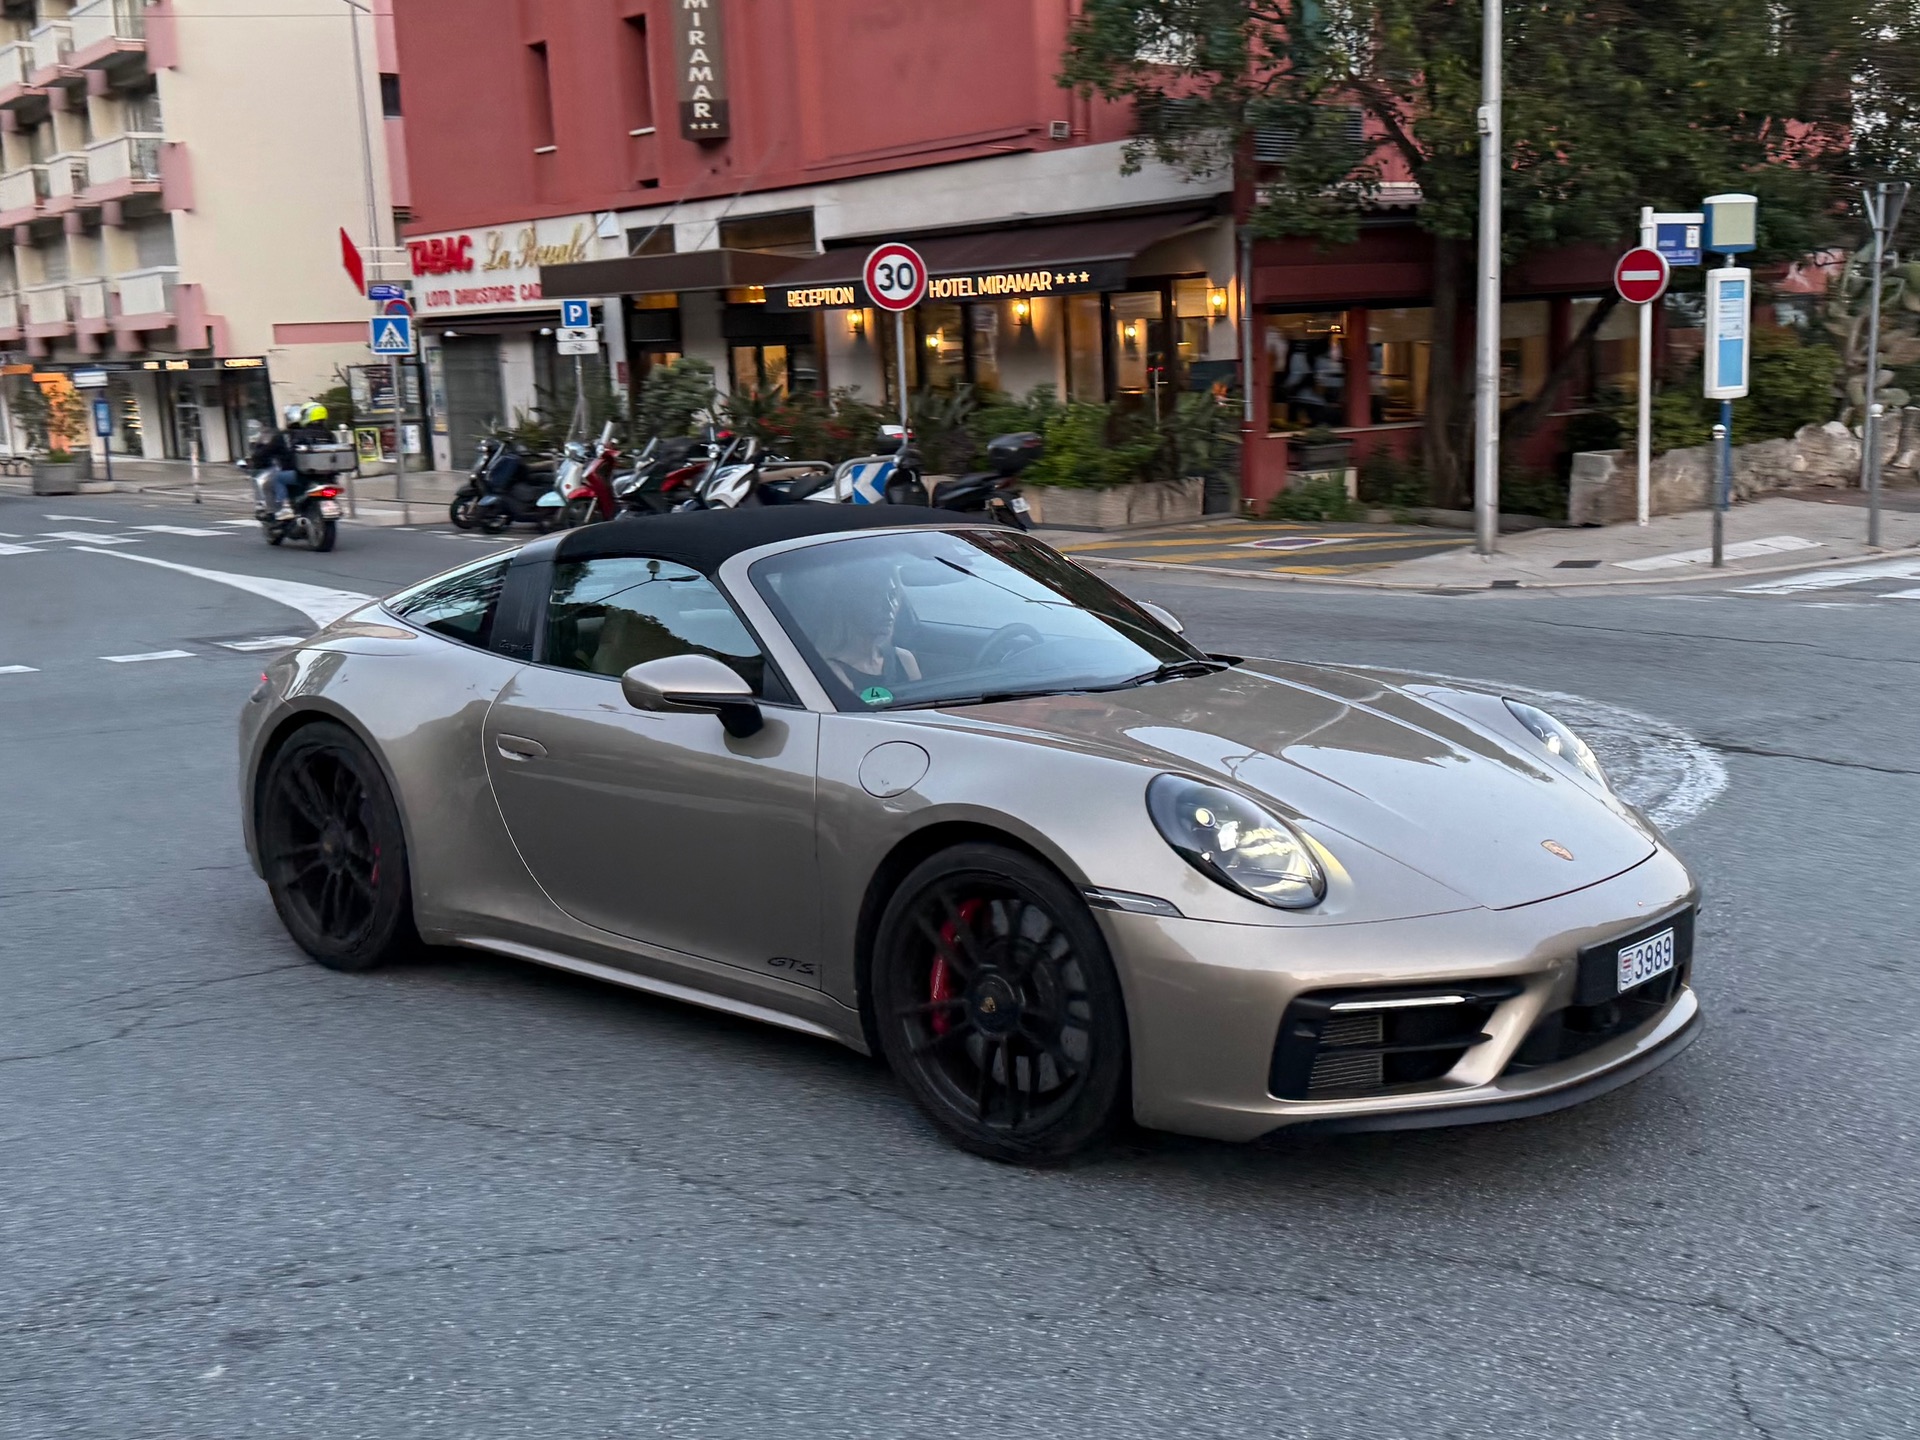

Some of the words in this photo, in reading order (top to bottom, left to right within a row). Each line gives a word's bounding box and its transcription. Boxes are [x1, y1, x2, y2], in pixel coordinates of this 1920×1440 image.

[406, 235, 473, 276] TABAC
[877, 262, 914, 292] 30
[928, 277, 979, 299] HOTEL
[977, 271, 1053, 295] MIRAMAR
[425, 289, 452, 307] LOTO
[787, 286, 854, 308] RECEPTION
[568, 304, 583, 323] P
[870, 687, 881, 698] 4
[767, 957, 816, 976] GTS
[1635, 936, 1671, 979] 3989
